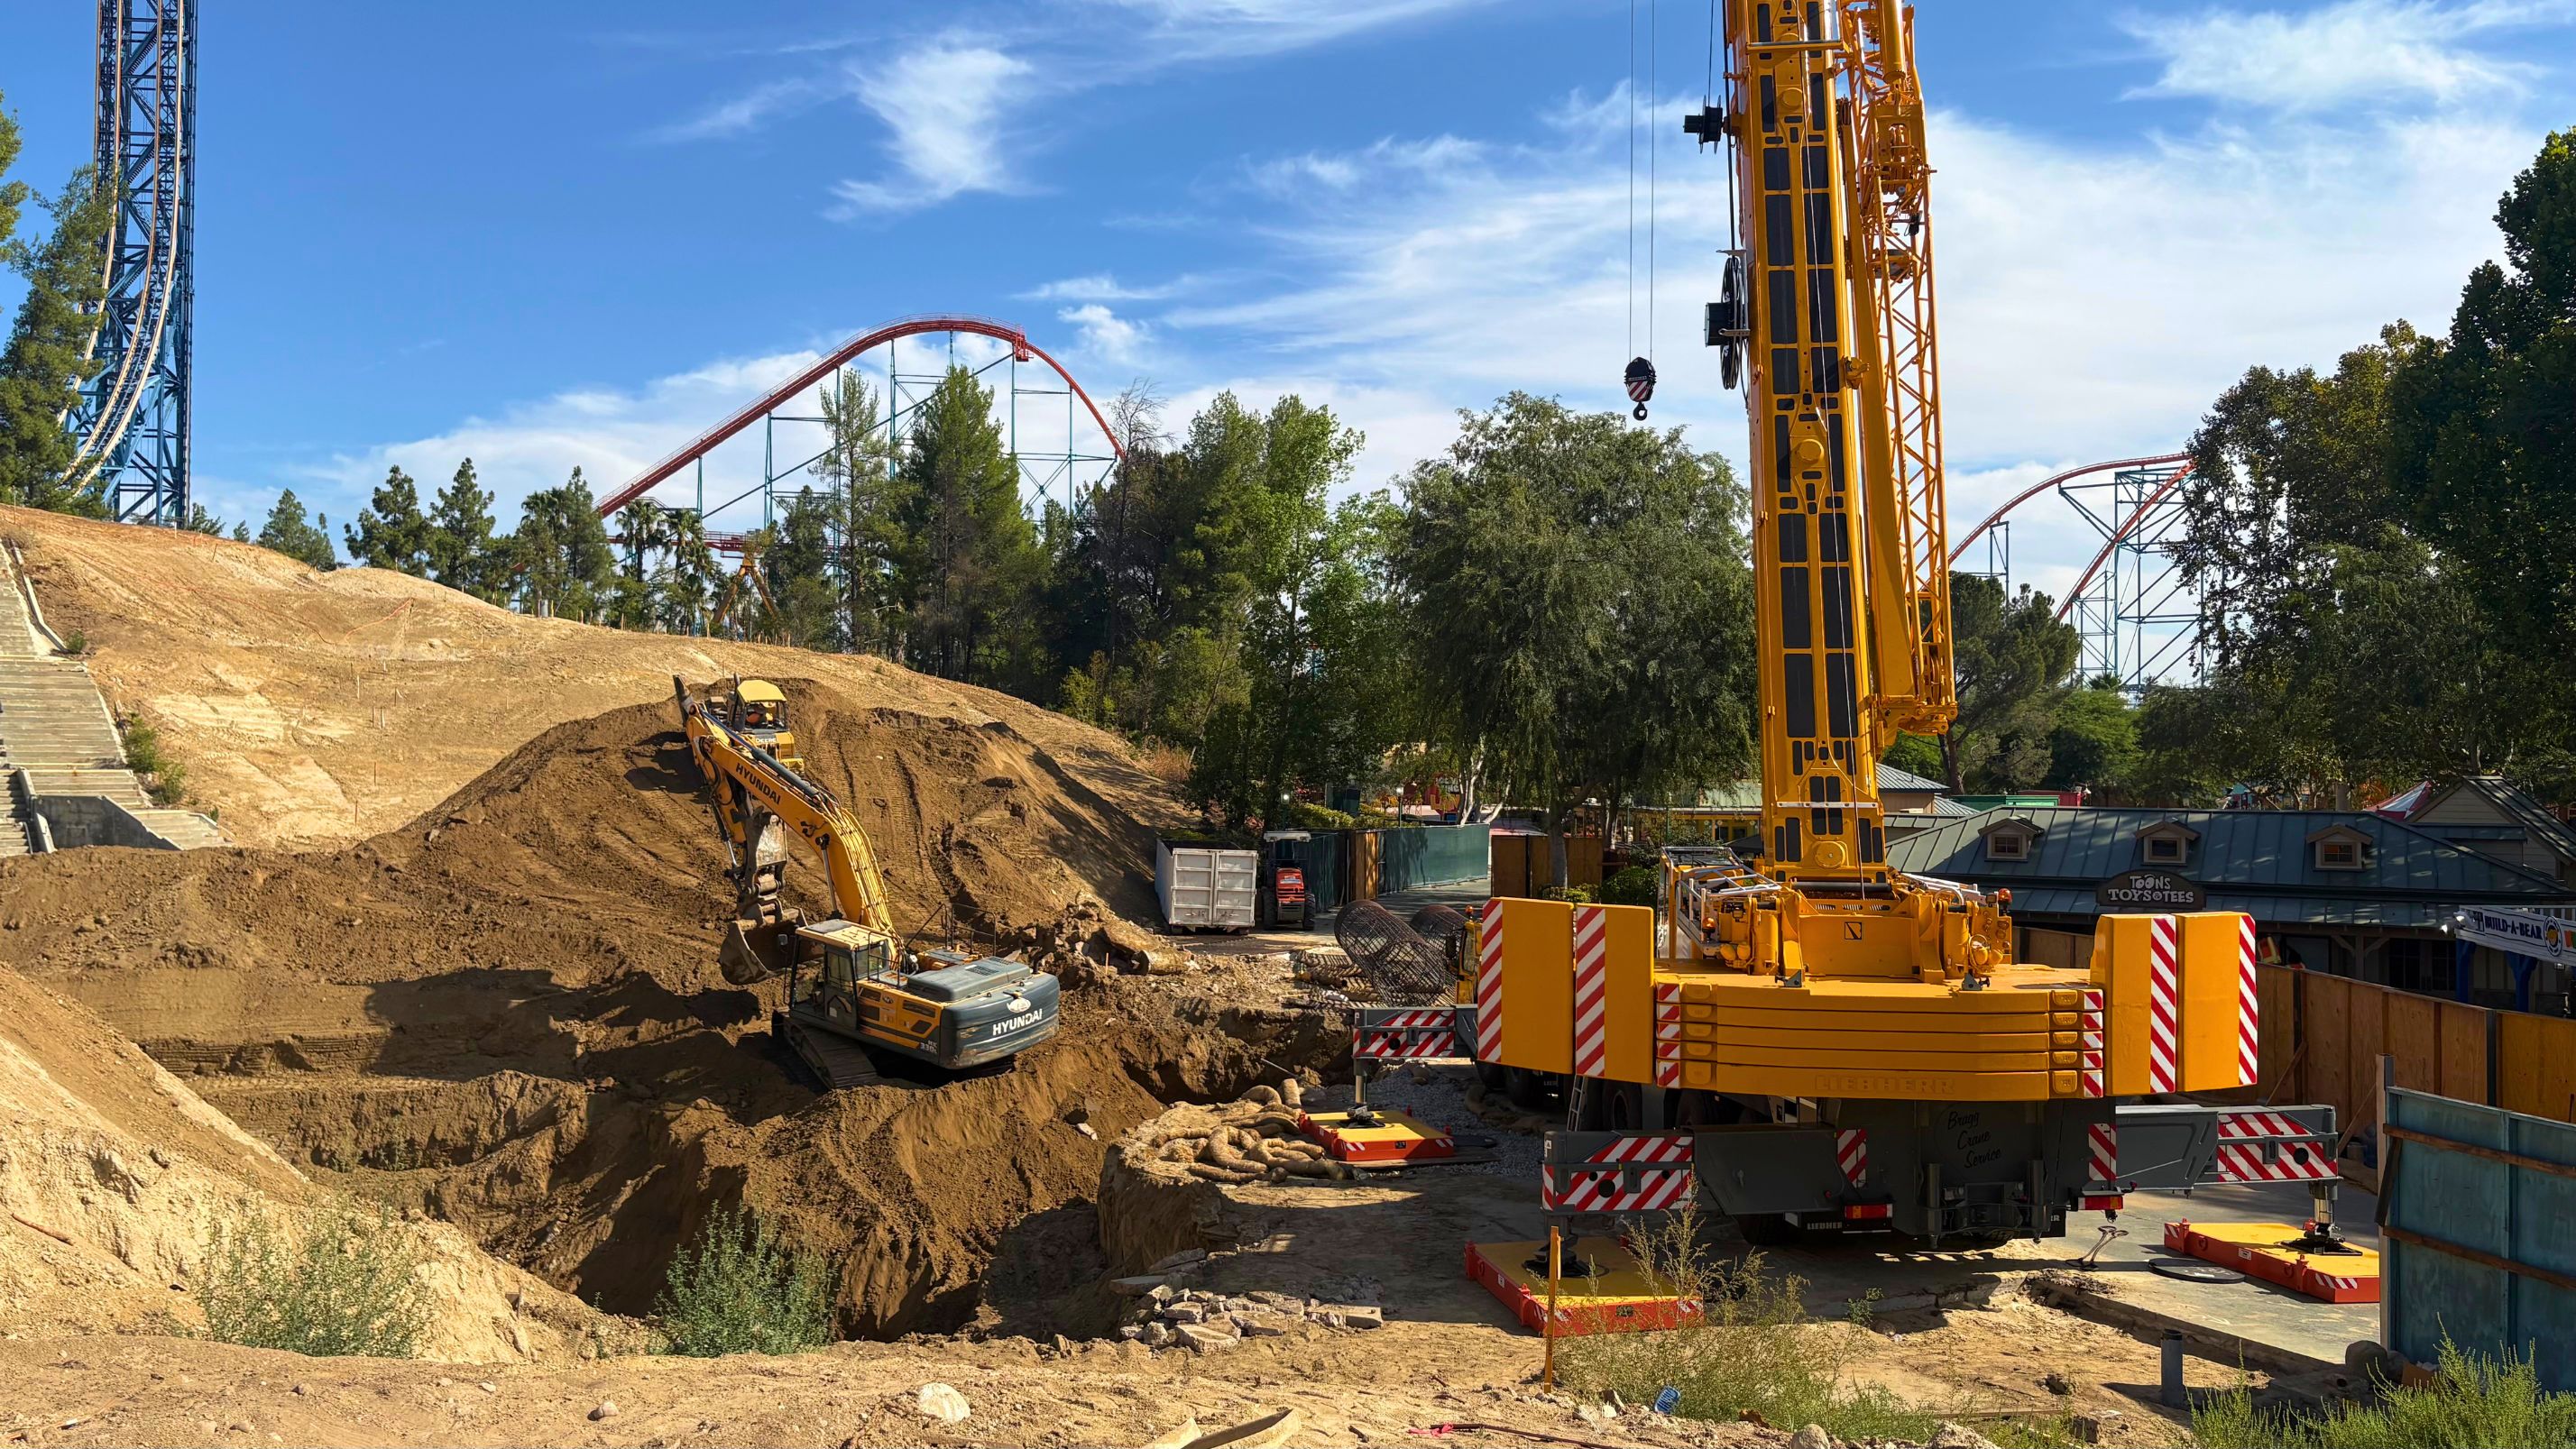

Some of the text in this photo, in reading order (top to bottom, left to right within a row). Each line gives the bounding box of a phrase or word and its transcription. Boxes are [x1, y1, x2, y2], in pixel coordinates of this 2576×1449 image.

[735, 762, 781, 805] HYUNDAI
[2484, 915, 2544, 940] BUILD-A-BEAR
[992, 1008, 1044, 1036] HYUNDAI
[1814, 1075, 1955, 1095] LIEBHERR
[1948, 1111, 1979, 1129] Bragg
[1957, 1130, 1991, 1150] Crane
[1964, 1148, 2001, 1168] Service
[1807, 1222, 1843, 1230] LIEBHER
